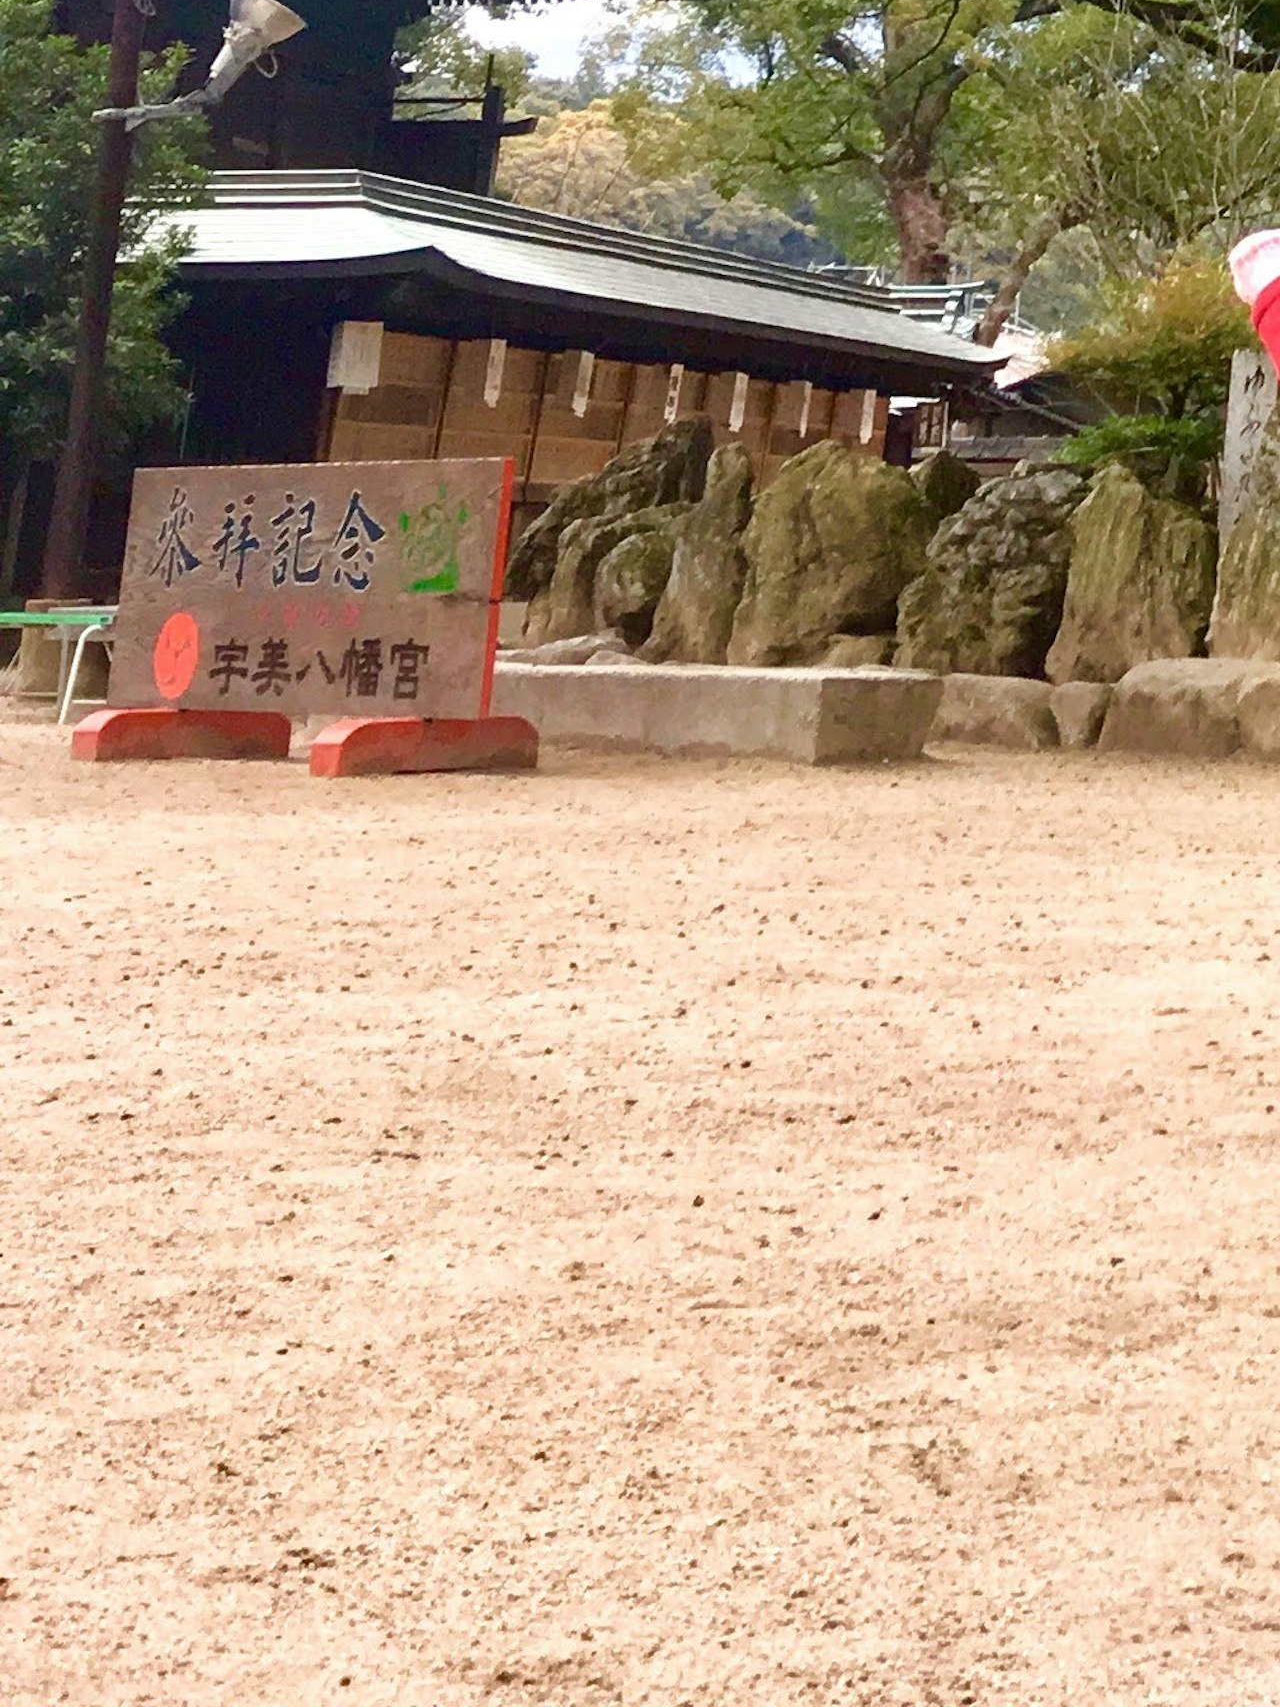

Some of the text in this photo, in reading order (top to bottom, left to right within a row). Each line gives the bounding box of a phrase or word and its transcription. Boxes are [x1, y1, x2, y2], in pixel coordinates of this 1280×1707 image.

[208, 637, 430, 699] 宇美八幡宮
